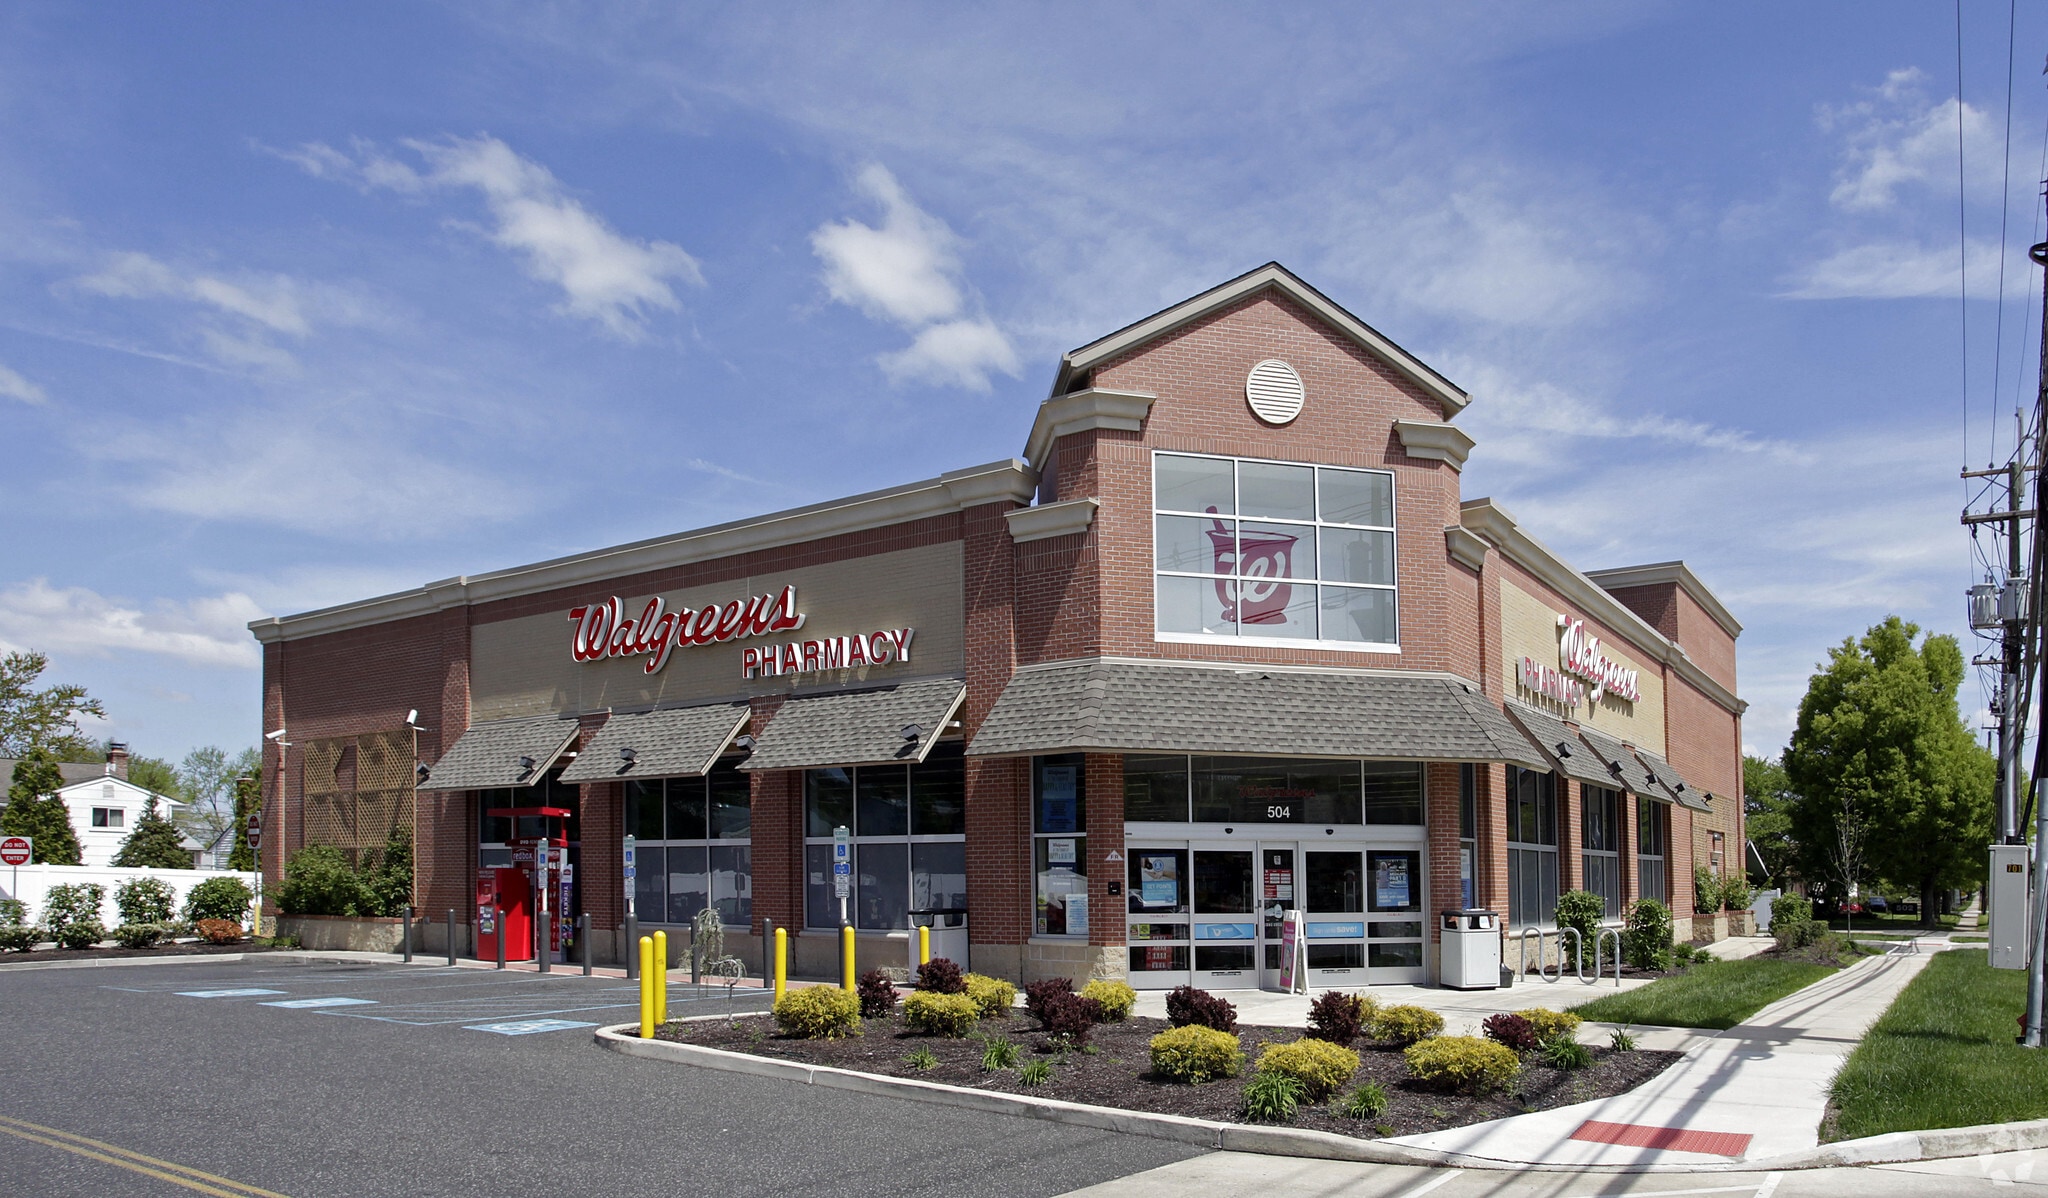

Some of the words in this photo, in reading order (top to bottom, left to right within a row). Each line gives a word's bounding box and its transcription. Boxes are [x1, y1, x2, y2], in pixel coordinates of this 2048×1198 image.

[567, 584, 806, 675] Walgreens
[742, 627, 915, 680] PHARMACY
[1557, 613, 1642, 703] Walgreens
[1517, 656, 1585, 709] PHARMACY
[1267, 805, 1291, 818] 504
[512, 851, 533, 860] redbox
[2007, 864, 2022, 873] 701
[1336, 925, 1358, 933] save!
